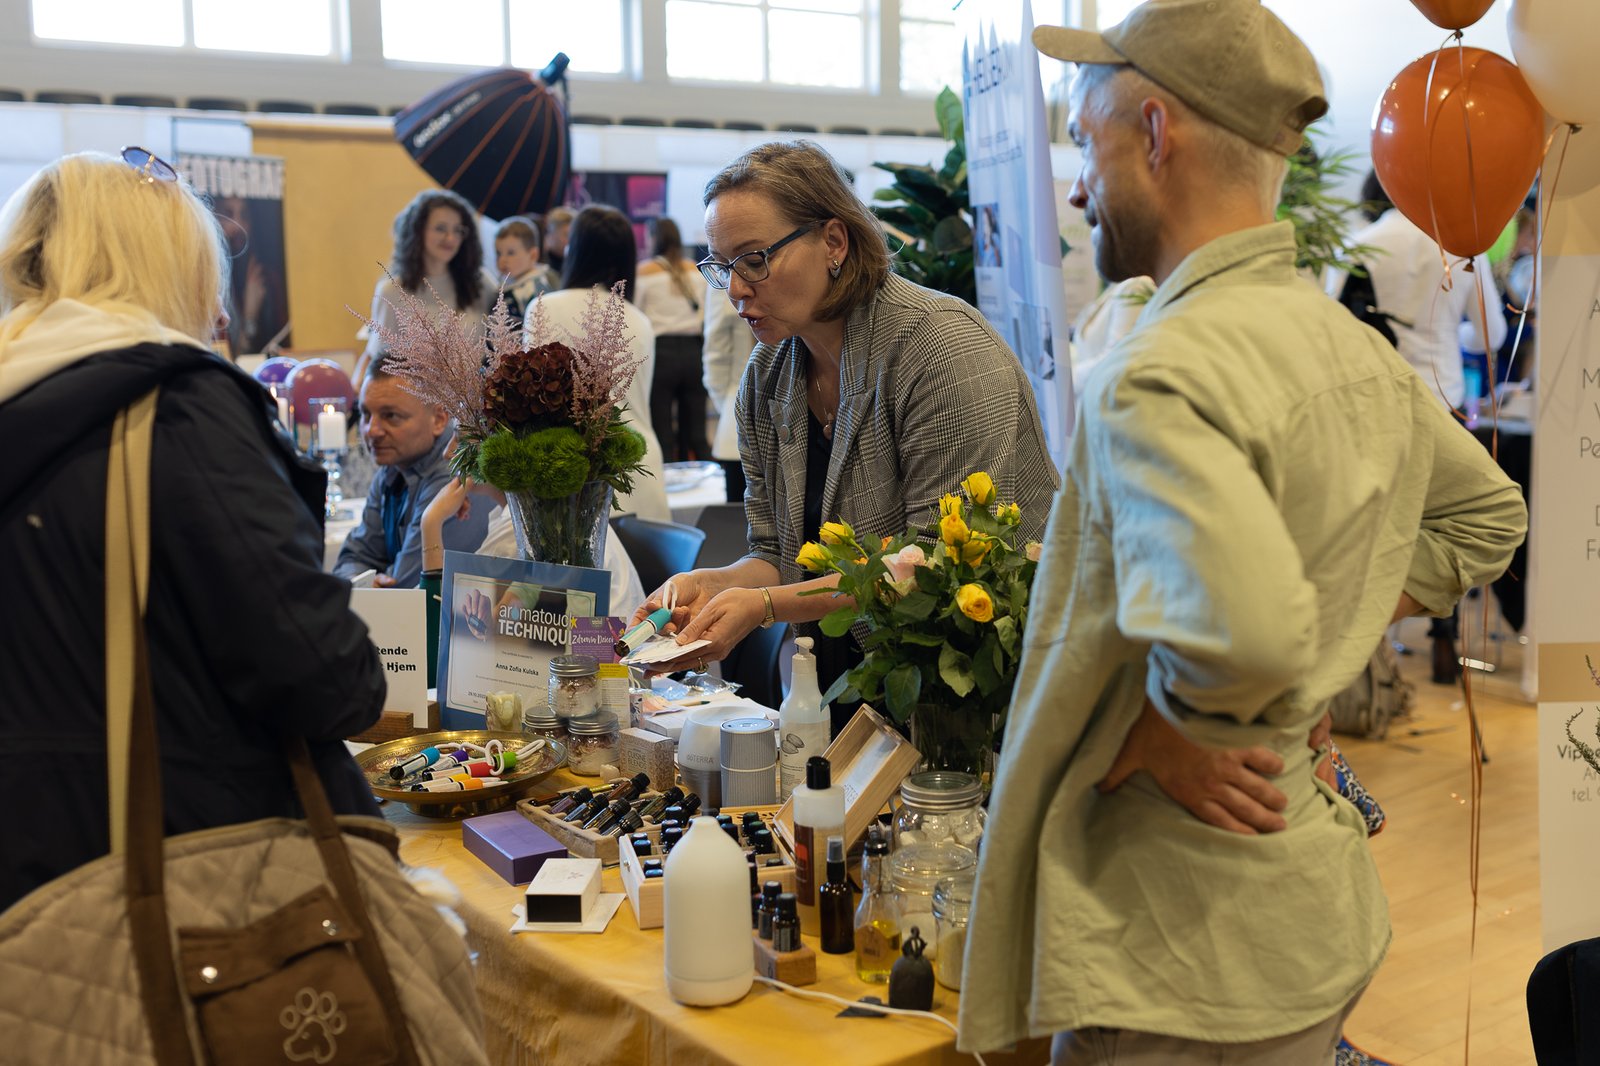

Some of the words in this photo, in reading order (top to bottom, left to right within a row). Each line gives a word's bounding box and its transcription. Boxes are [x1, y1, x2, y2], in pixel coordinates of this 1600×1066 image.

[386, 662, 416, 673] Hjem
[495, 663, 508, 671] Anna
[508, 664, 522, 673] Zofia
